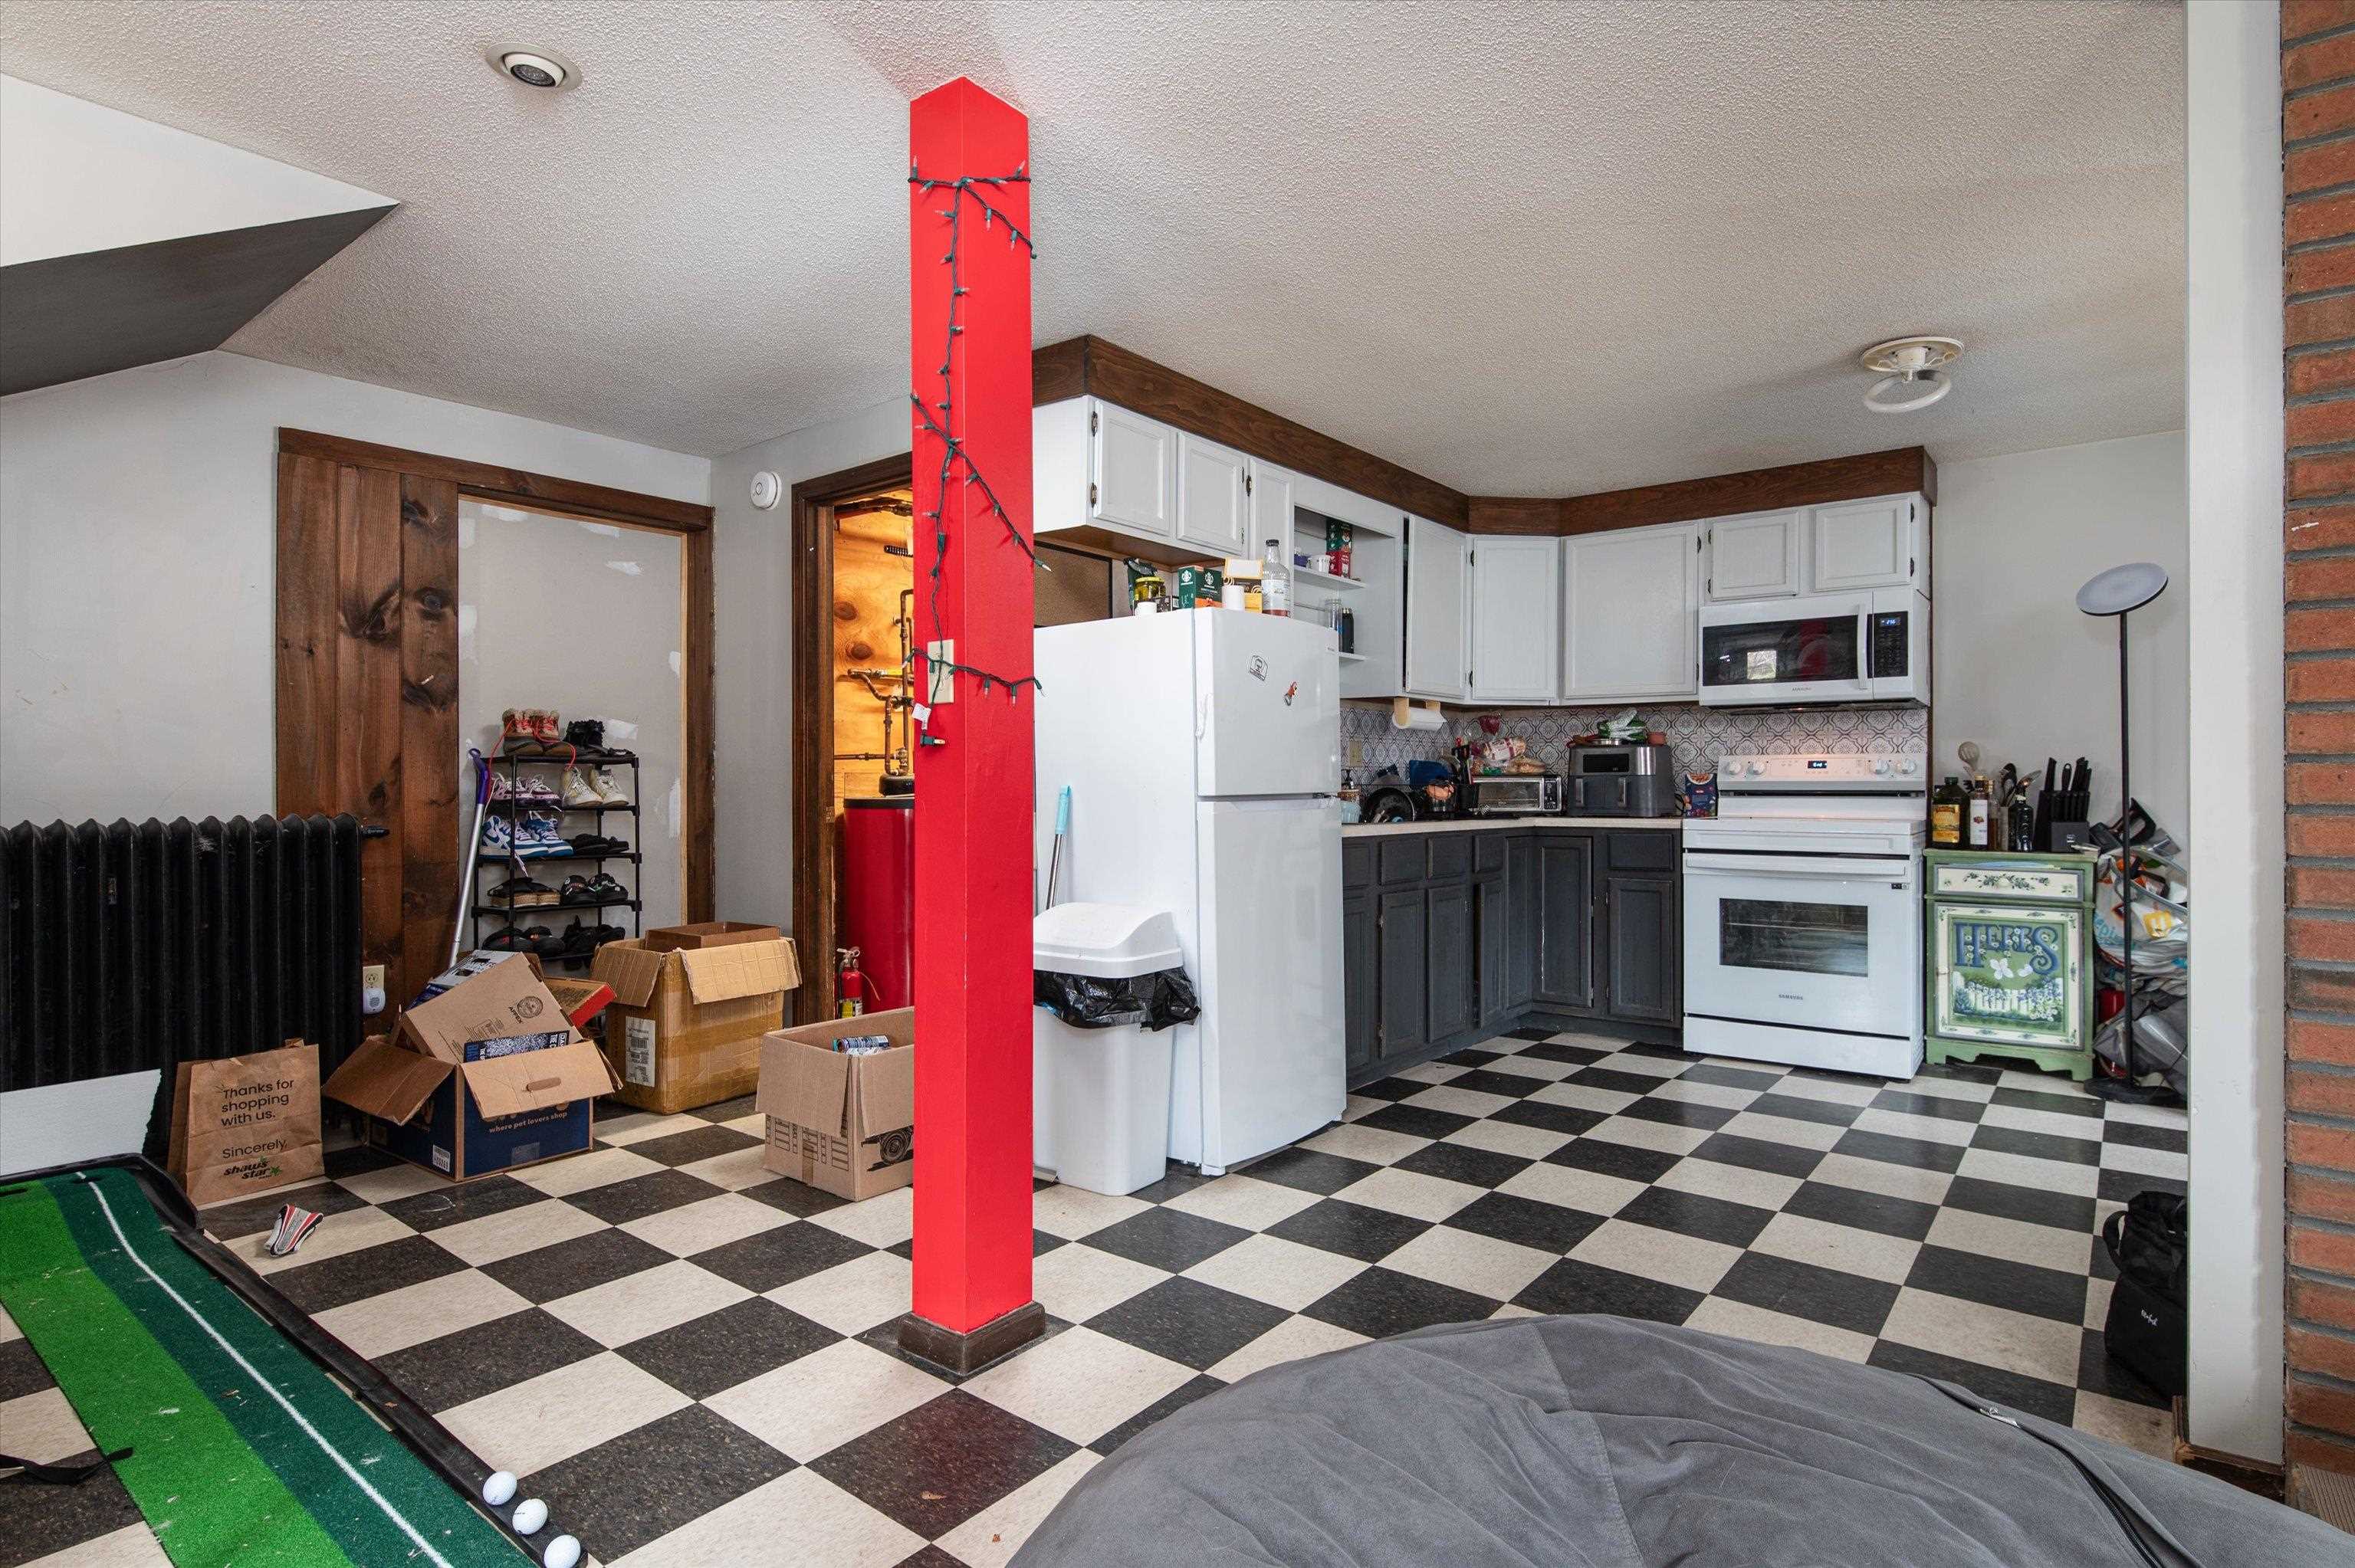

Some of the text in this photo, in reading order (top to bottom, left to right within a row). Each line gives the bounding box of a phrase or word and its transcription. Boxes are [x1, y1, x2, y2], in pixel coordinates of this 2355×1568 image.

[1955, 923, 2058, 975] HERBS
[223, 1079, 294, 1099] Thanks for
[222, 1094, 289, 1112] shopping
[221, 1110, 276, 1127] with us.
[489, 1124, 513, 1133] where
[514, 1120, 527, 1130] pet
[527, 1116, 550, 1125] lovers
[550, 1112, 567, 1120] shop
[222, 1139, 288, 1159] Sincerely,
[241, 1168, 271, 1179] star
